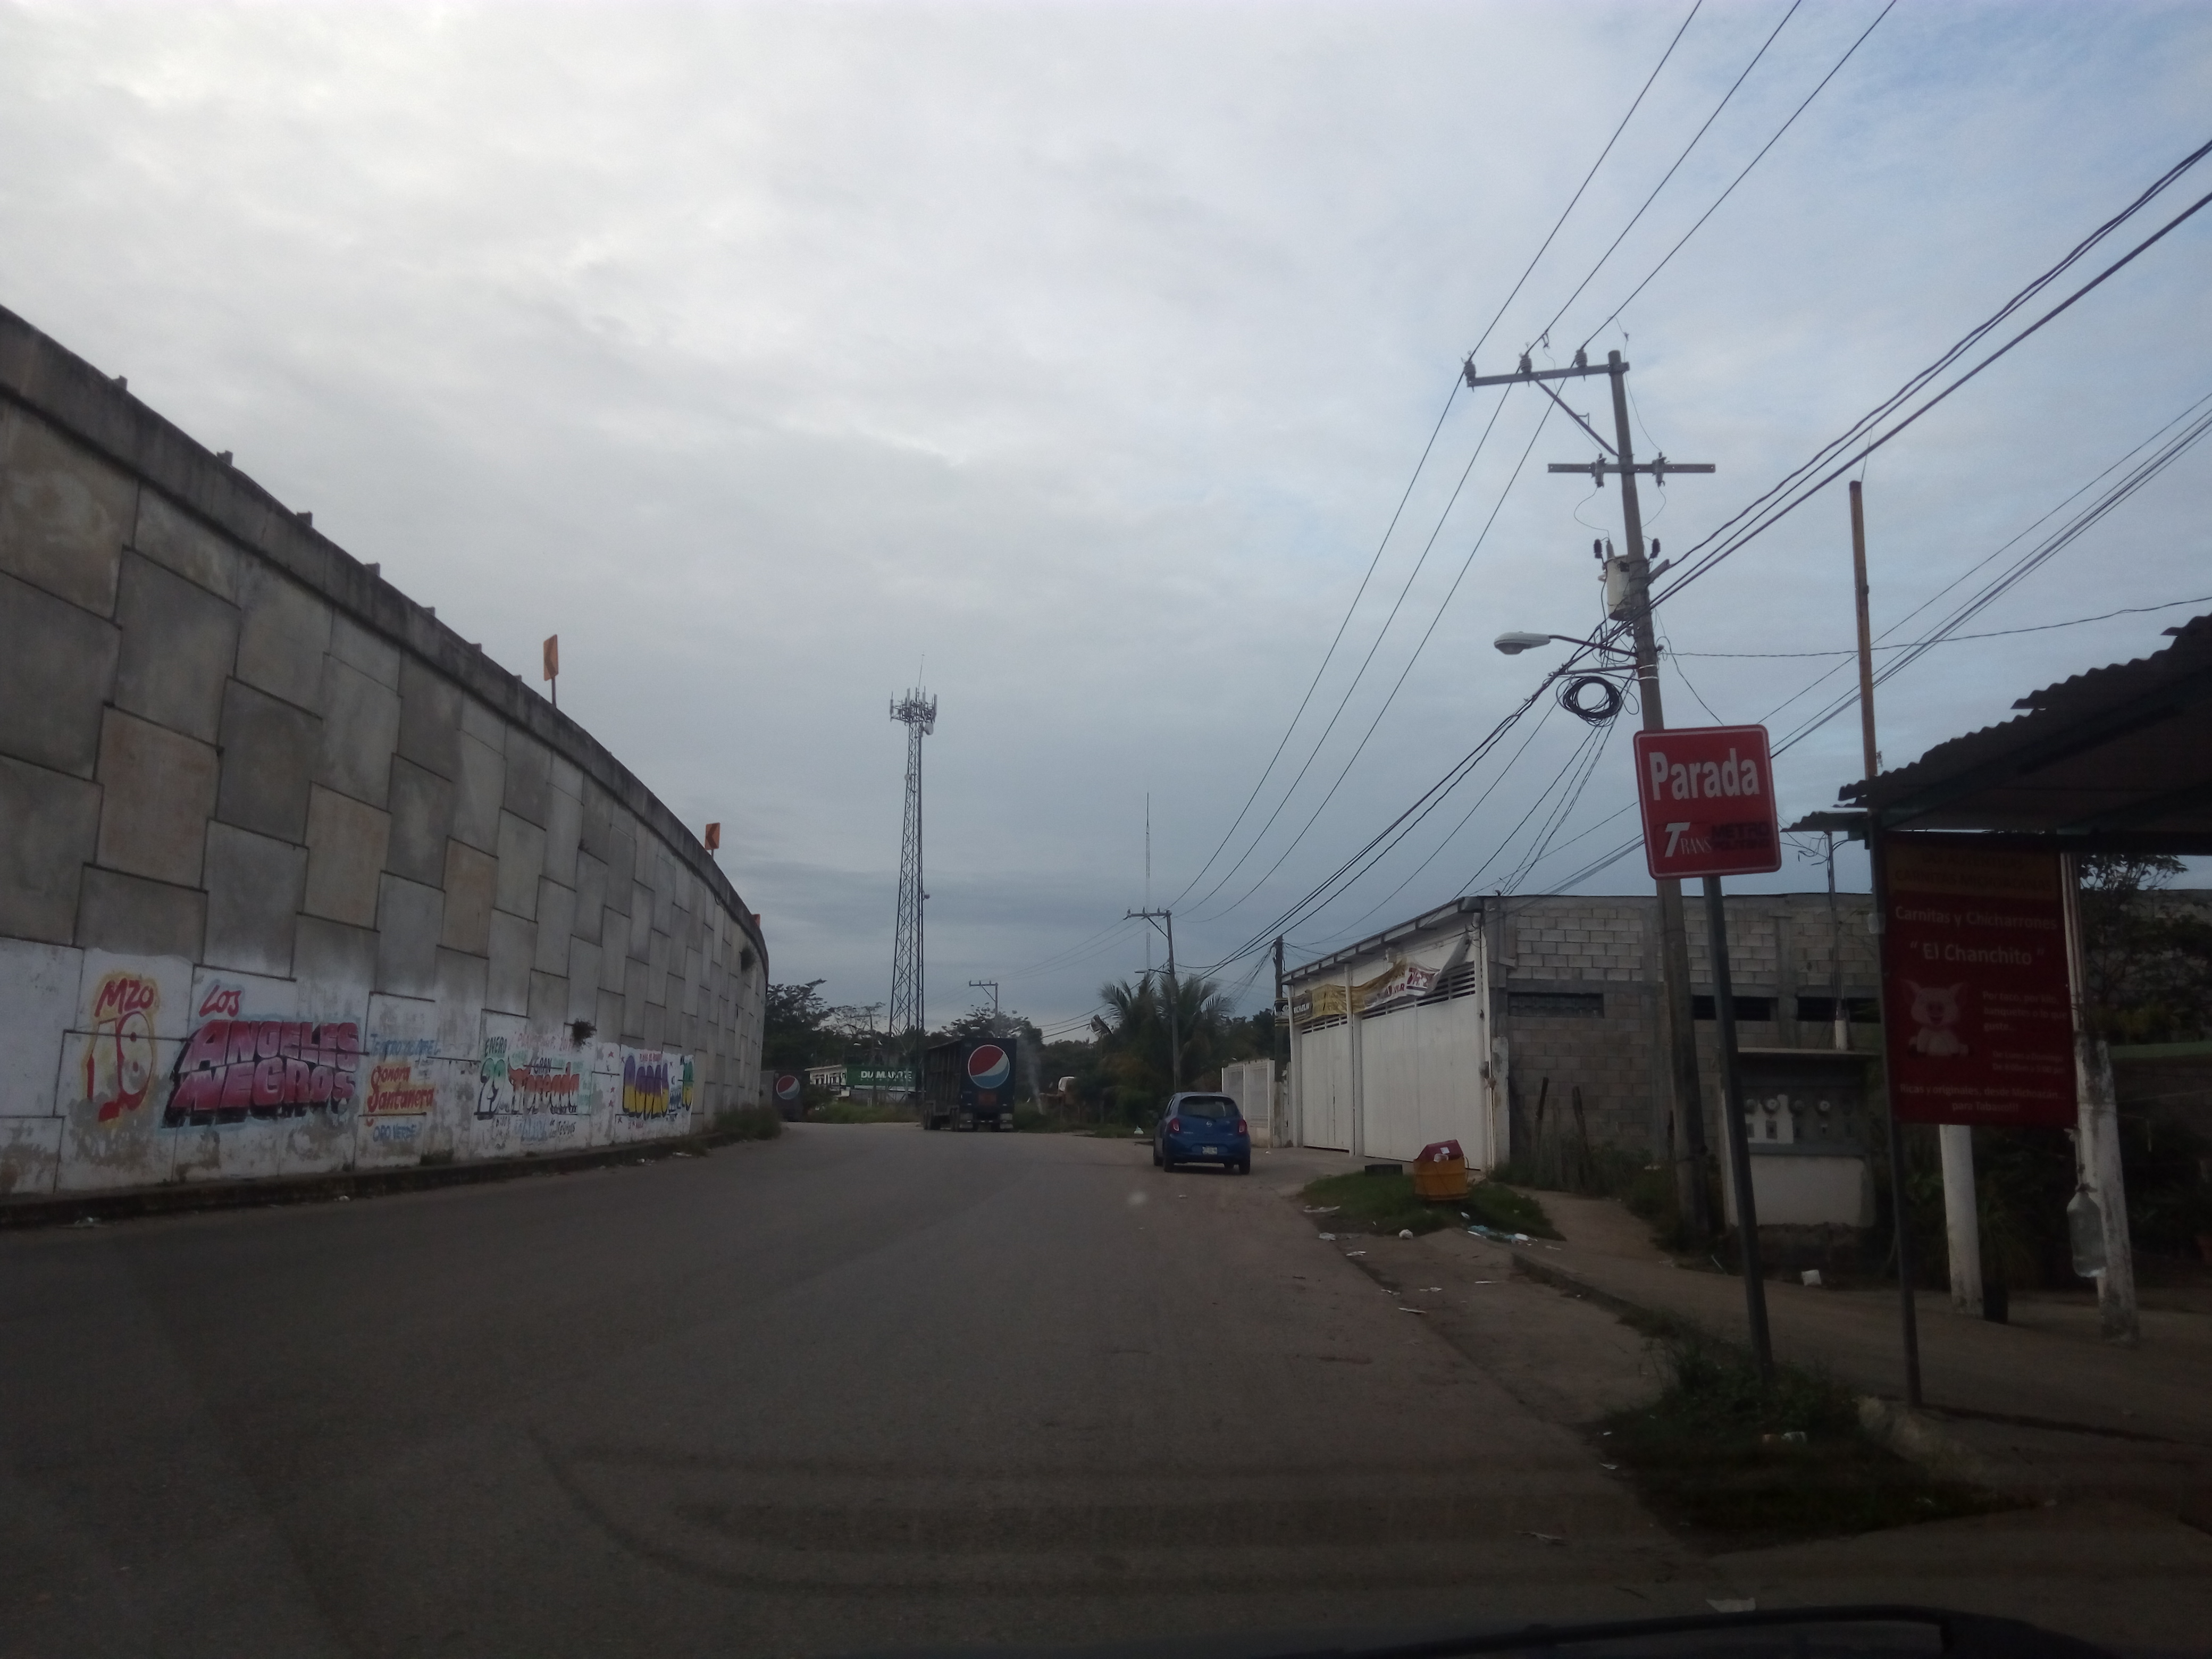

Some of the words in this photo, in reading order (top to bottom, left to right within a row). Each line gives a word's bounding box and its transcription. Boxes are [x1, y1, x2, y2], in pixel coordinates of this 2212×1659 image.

[1649, 748, 1760, 801] Parada
[1895, 869, 1957, 885] CARNITAS
[1895, 906, 1950, 924] Carnitas
[1954, 914, 1962, 927] y
[1966, 911, 2057, 930] Chicharrones
[1923, 942, 1939, 960] El
[1944, 944, 2032, 965] Chanchito
[199, 984, 241, 1017] LOS
[1982, 991, 1997, 1000] Por
[2024, 994, 2039, 1004] por
[178, 1019, 359, 1073] ANGELES
[484, 1036, 507, 1058] ENERO
[169, 1057, 356, 1113] NEGROS
[1900, 1083, 1924, 1094] Ricas
[1984, 1086, 2009, 1096] desde
[1951, 1102, 1973, 1112] para
